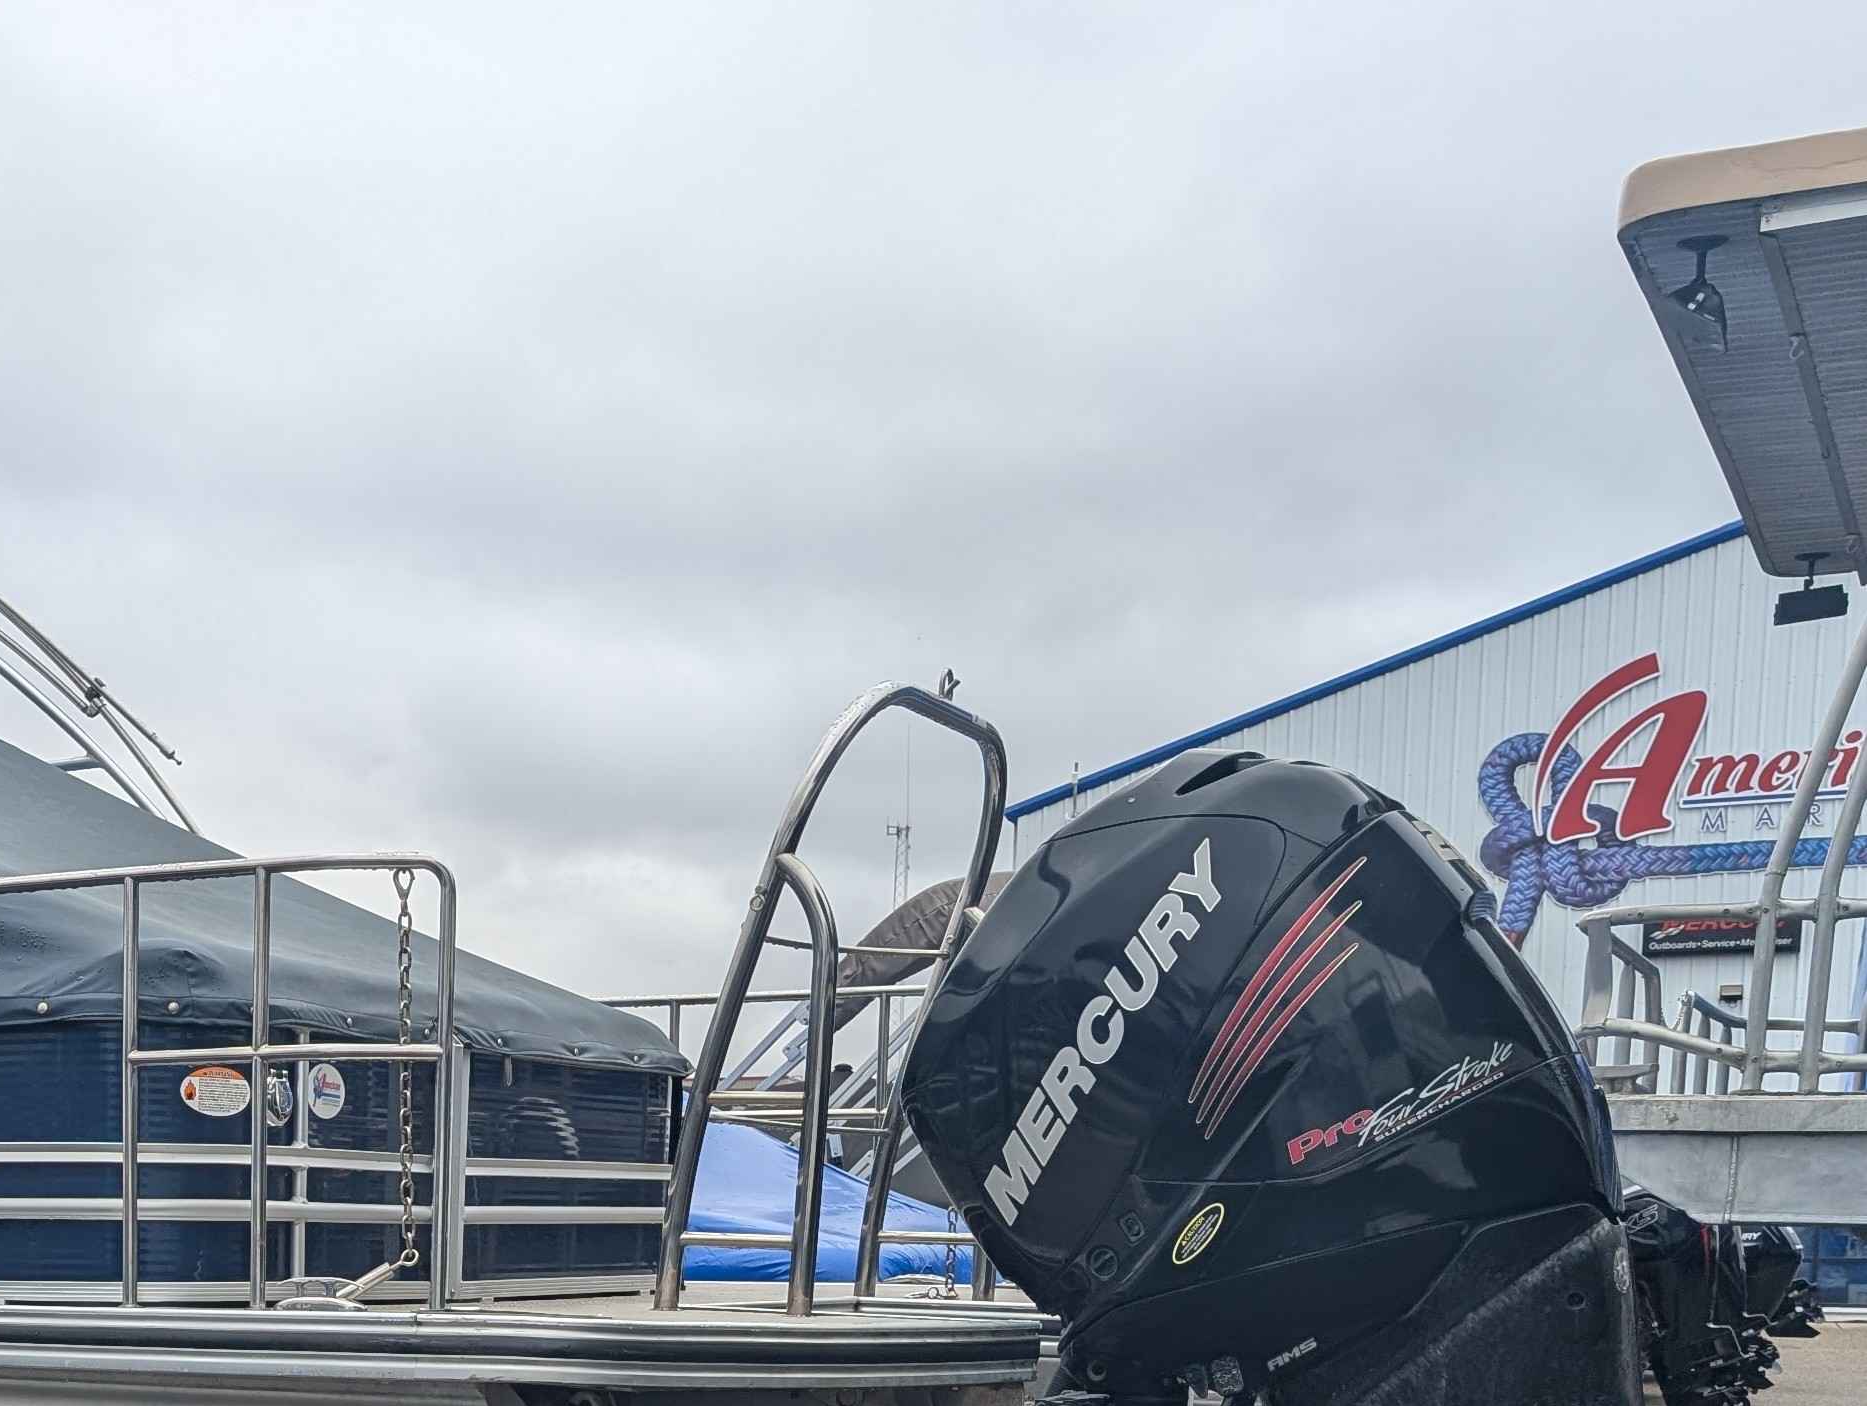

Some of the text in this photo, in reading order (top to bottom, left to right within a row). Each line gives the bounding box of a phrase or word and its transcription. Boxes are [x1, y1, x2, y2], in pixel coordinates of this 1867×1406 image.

[1648, 940, 1697, 950] Outboards
[1701, 939, 1735, 949] Service
[983, 838, 1222, 1227] MERCURY
[1375, 1071, 1505, 1143] SUPERCHARGED
[1287, 1109, 1375, 1165] Pro
[1267, 1337, 1317, 1372] AMS
